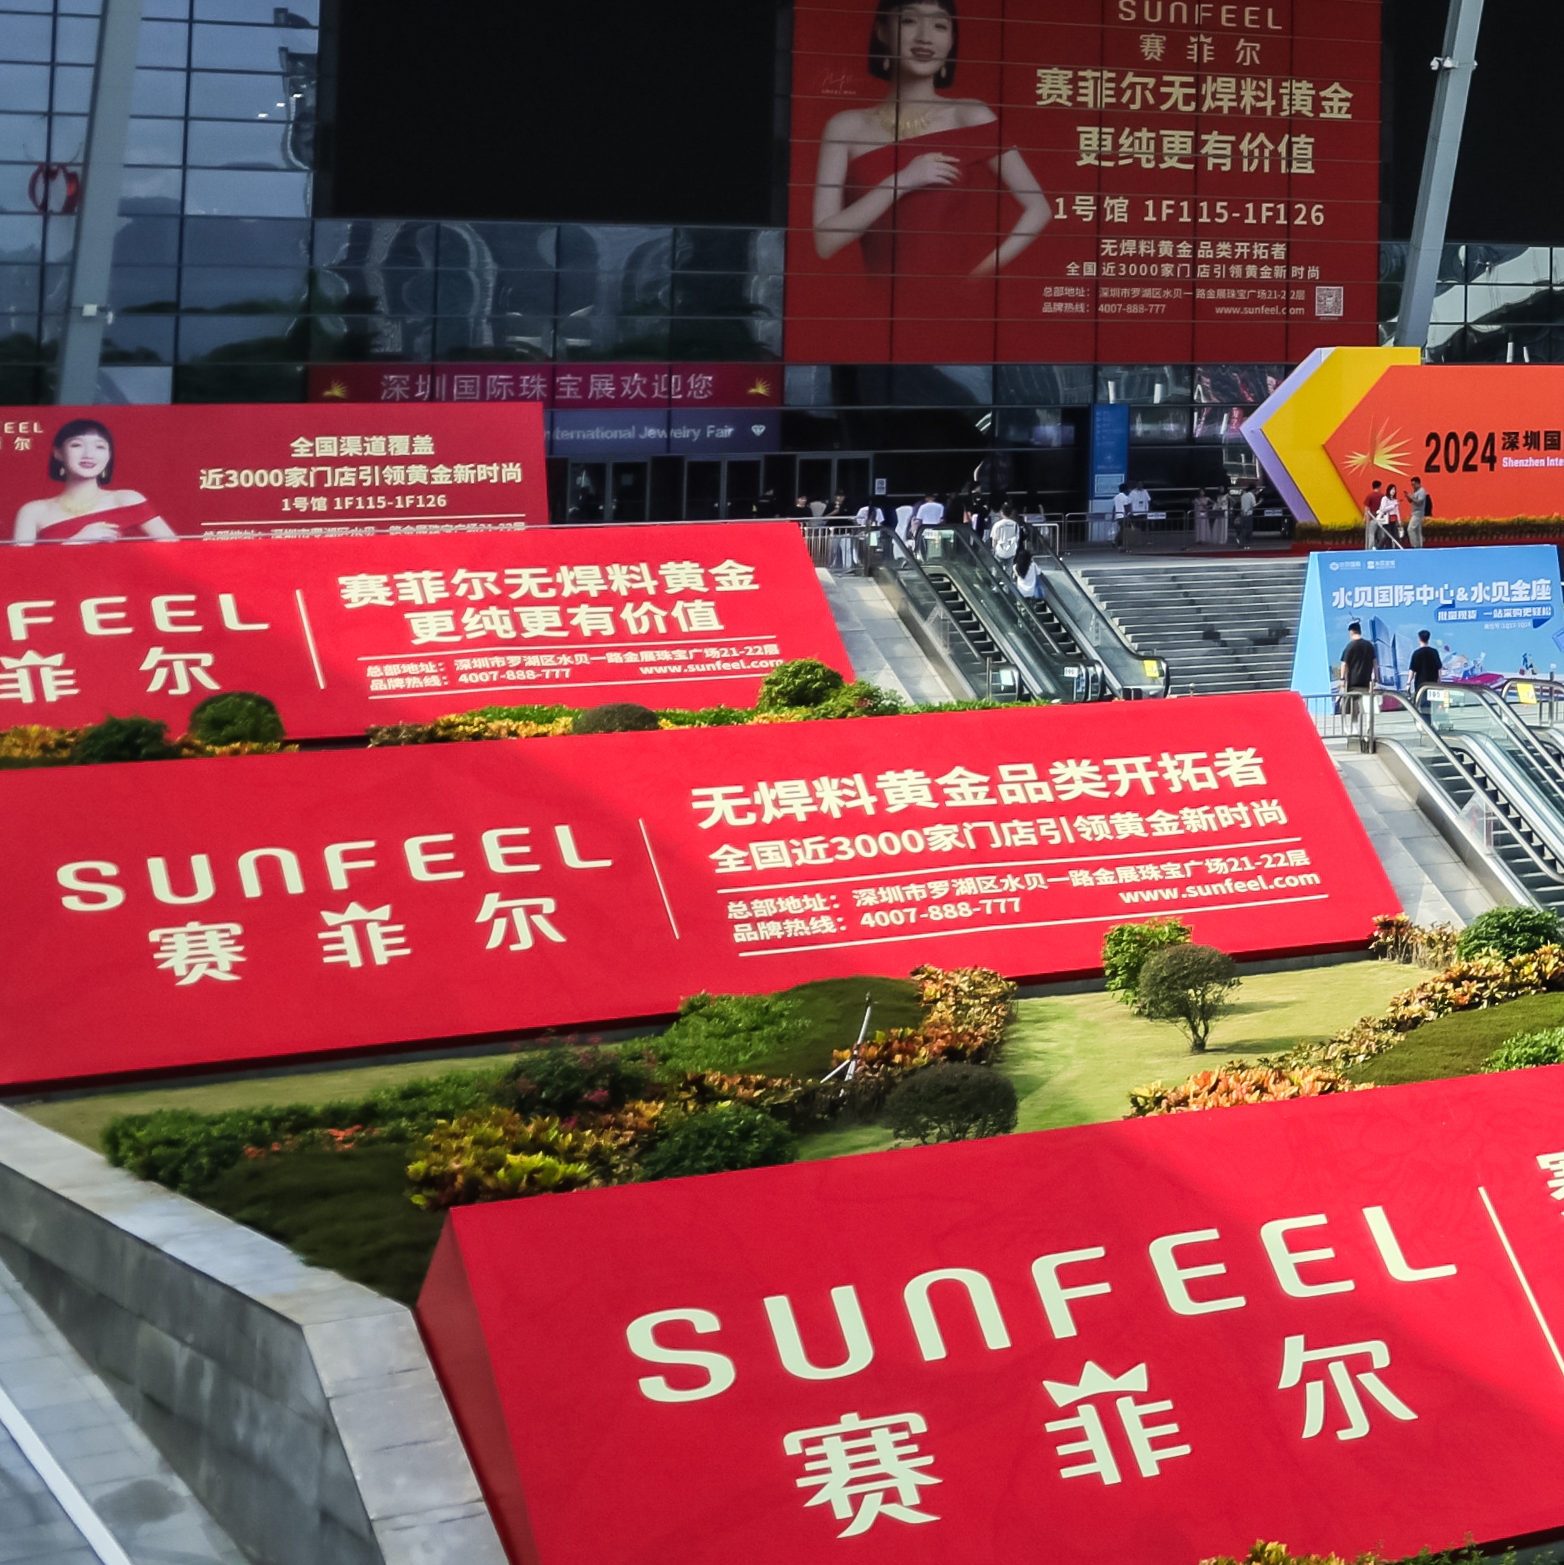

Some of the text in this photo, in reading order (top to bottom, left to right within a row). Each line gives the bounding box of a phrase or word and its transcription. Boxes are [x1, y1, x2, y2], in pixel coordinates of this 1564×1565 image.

[1139, 33, 1262, 67] 赛菲尔
[1035, 67, 1354, 121] 赛菲尔无焊料黄金
[1075, 126, 1317, 175] 更纯更有价值
[1054, 195, 1325, 227] 1号馆 1F115-1F126
[1066, 261, 1320, 280] 全国近3000家门店引领黄金新时尚
[1100, 239, 1287, 260] 无焊料黄金品类开拓者
[1215, 305, 1305, 316] www.sunfeel.com
[381, 373, 713, 401] 深圳国际珠宝展欢迎您
[291, 436, 435, 458] 全国渠道覆盖
[707, 425, 734, 439] Fair
[1424, 431, 1497, 474] 2024
[199, 463, 523, 489] 近3000家门店引领黄金新时尚
[1502, 456, 1545, 468] Shenzhen
[282, 494, 447, 512] 1号馆 1F115-1F126
[338, 560, 760, 609] 赛菲尔无焊料黄金
[1332, 578, 1552, 610] 水贝国际中心&水贝金座
[404, 600, 724, 646] 更纯更有价值
[691, 747, 1268, 831] 无焊料黄金品类开拓者
[707, 798, 1288, 876] 全国近3000家门店引领黄金新时尚
[56, 824, 611, 912] SUNFEEL
[727, 848, 1311, 922] 总部地址：深圳市罗湖区水贝一路金展珠宝广场21-22层
[733, 870, 1321, 944] 品牌热线：4007-888-777 www.sunfeel.com
[149, 892, 566, 986] 赛菲尔
[626, 1205, 1457, 1403] SUNFEEL
[783, 1334, 1419, 1539] 赛菲尔
